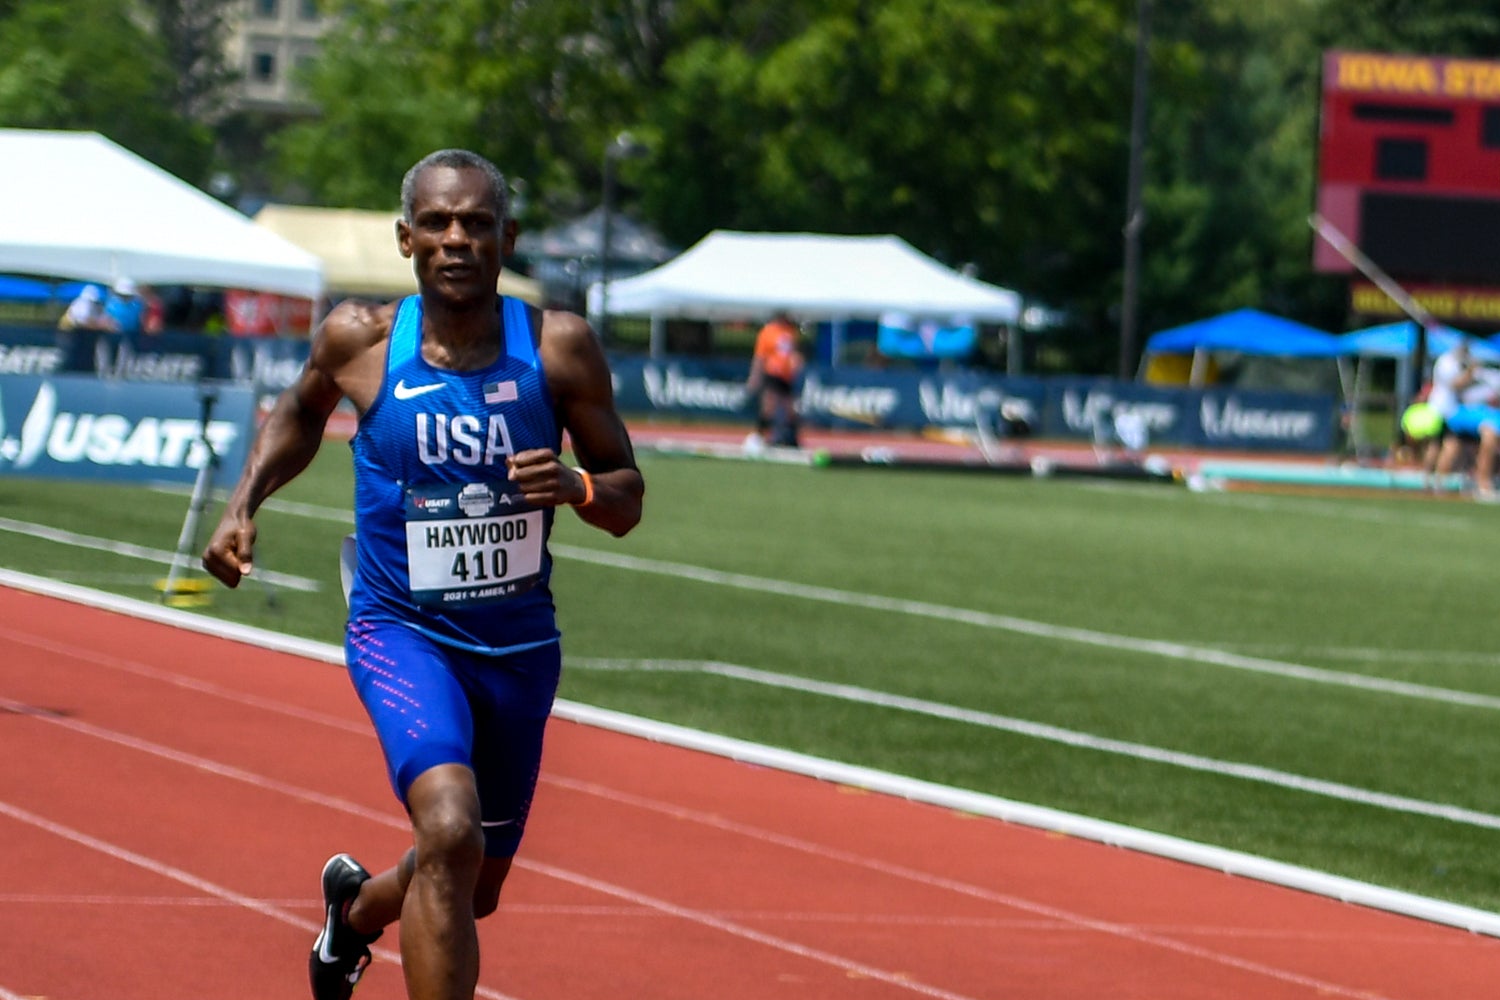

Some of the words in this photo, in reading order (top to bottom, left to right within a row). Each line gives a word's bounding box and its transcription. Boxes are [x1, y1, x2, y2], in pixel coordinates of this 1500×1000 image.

[1337, 55, 1437, 94] IOWA
[47, 411, 238, 468] USATF
[416, 412, 515, 466] USA
[425, 518, 528, 549] HAYWOOD
[451, 548, 508, 583] 410
[443, 591, 468, 602] 2021
